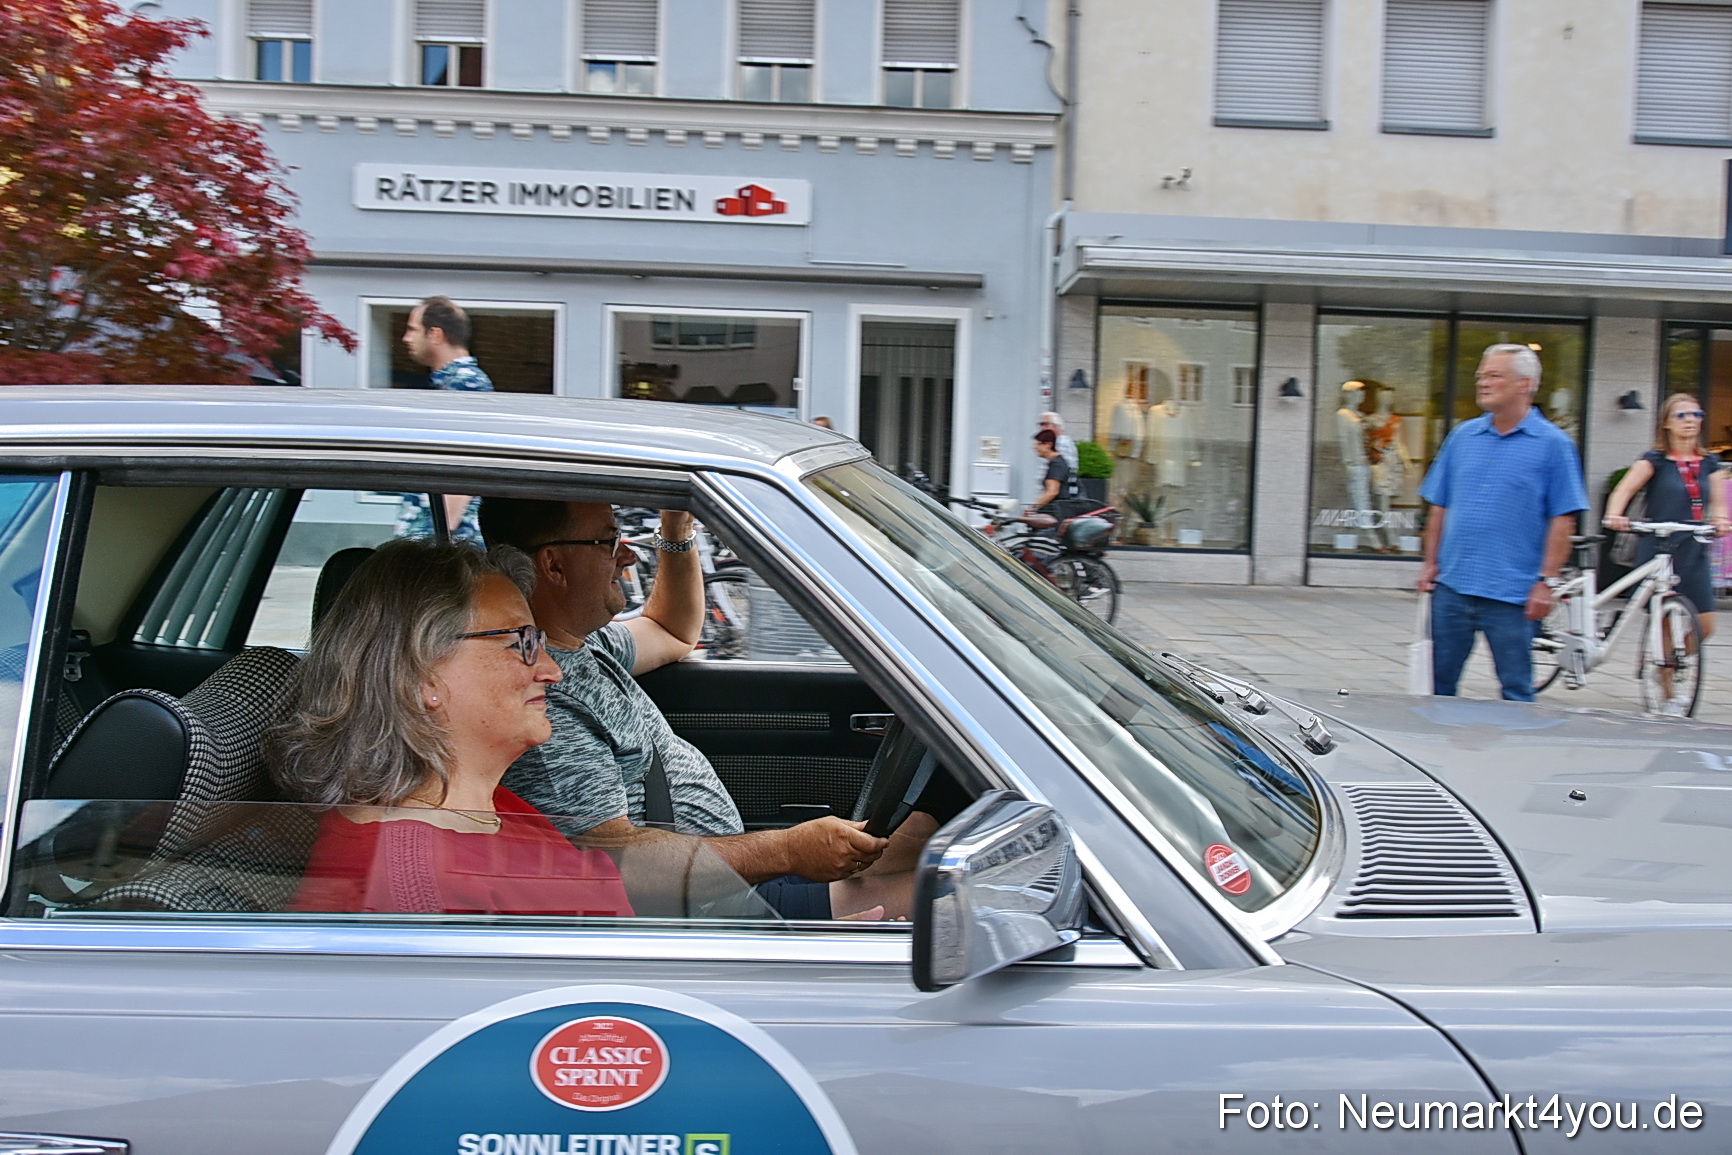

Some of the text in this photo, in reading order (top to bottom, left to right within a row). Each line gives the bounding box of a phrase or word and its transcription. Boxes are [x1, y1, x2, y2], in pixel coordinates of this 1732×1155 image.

[375, 172, 696, 212] RÄTZER IMMOBILIEN
[549, 1046, 653, 1065] CLASSIC
[554, 1068, 644, 1087] SPRINT
[457, 1133, 681, 1155] SONNLEITNER
